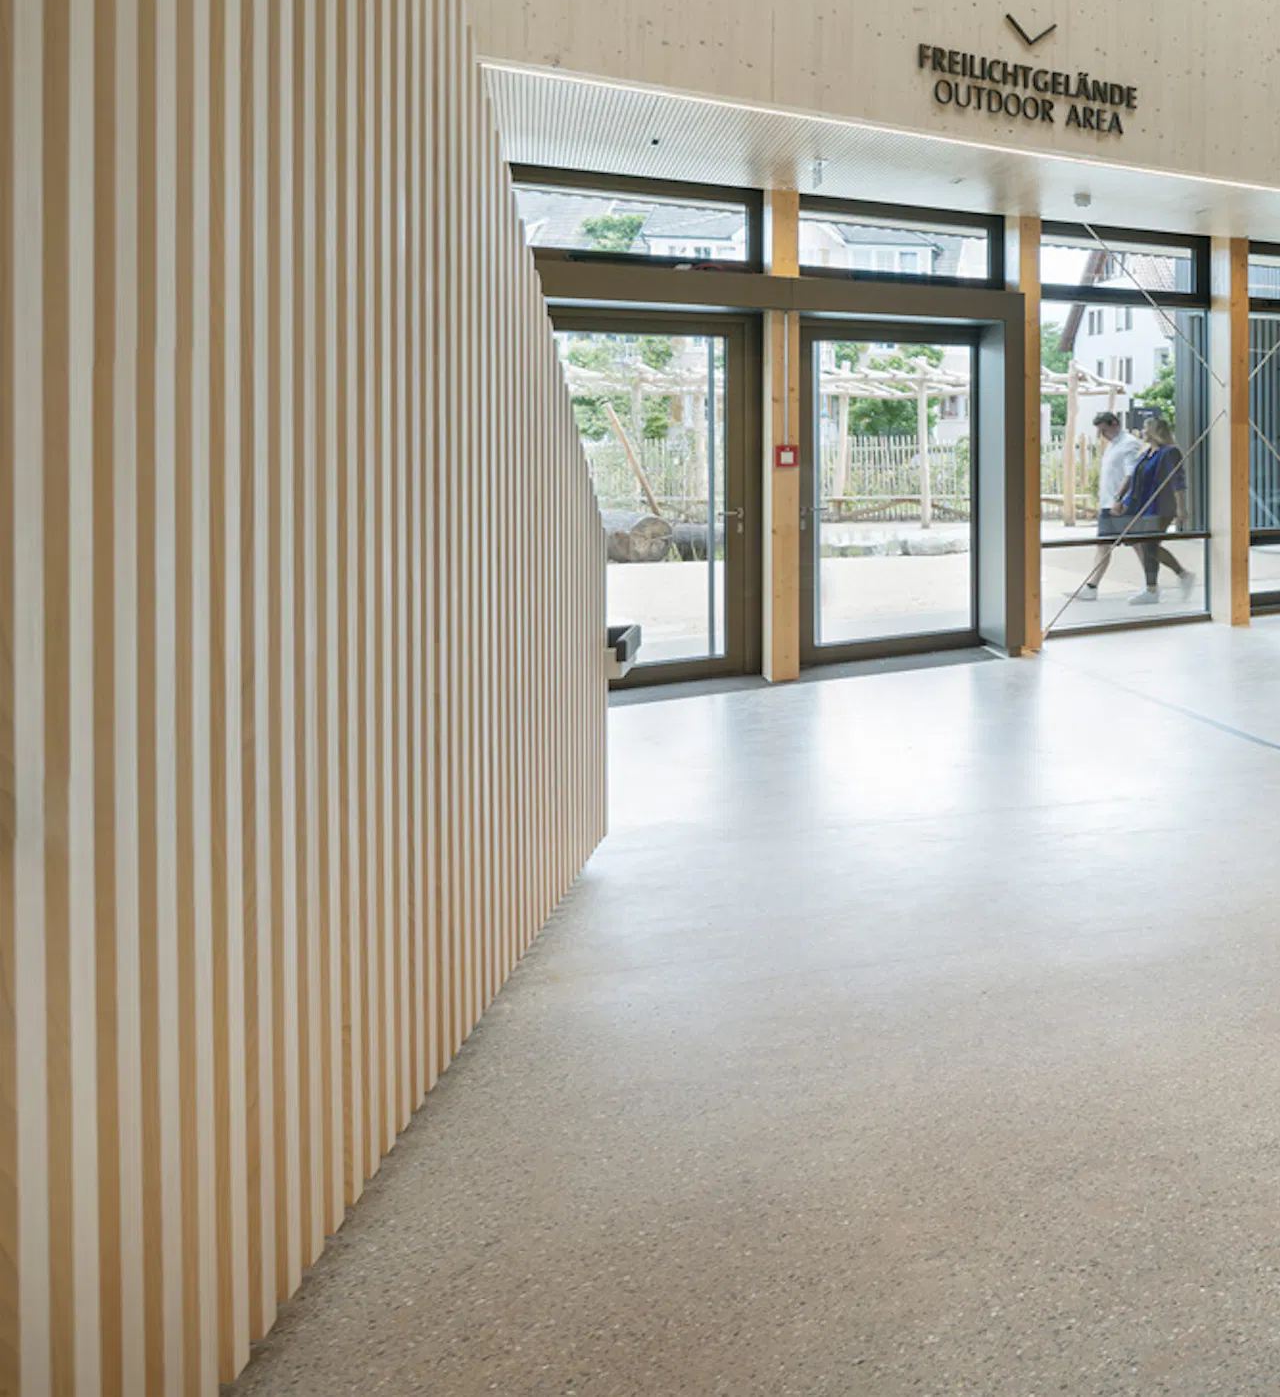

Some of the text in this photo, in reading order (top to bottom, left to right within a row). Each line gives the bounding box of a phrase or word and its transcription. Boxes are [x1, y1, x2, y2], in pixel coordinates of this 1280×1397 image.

[918, 44, 1137, 109] FREILICHTGELÄNDE
[934, 79, 1124, 134] OUTDOOR AREA
